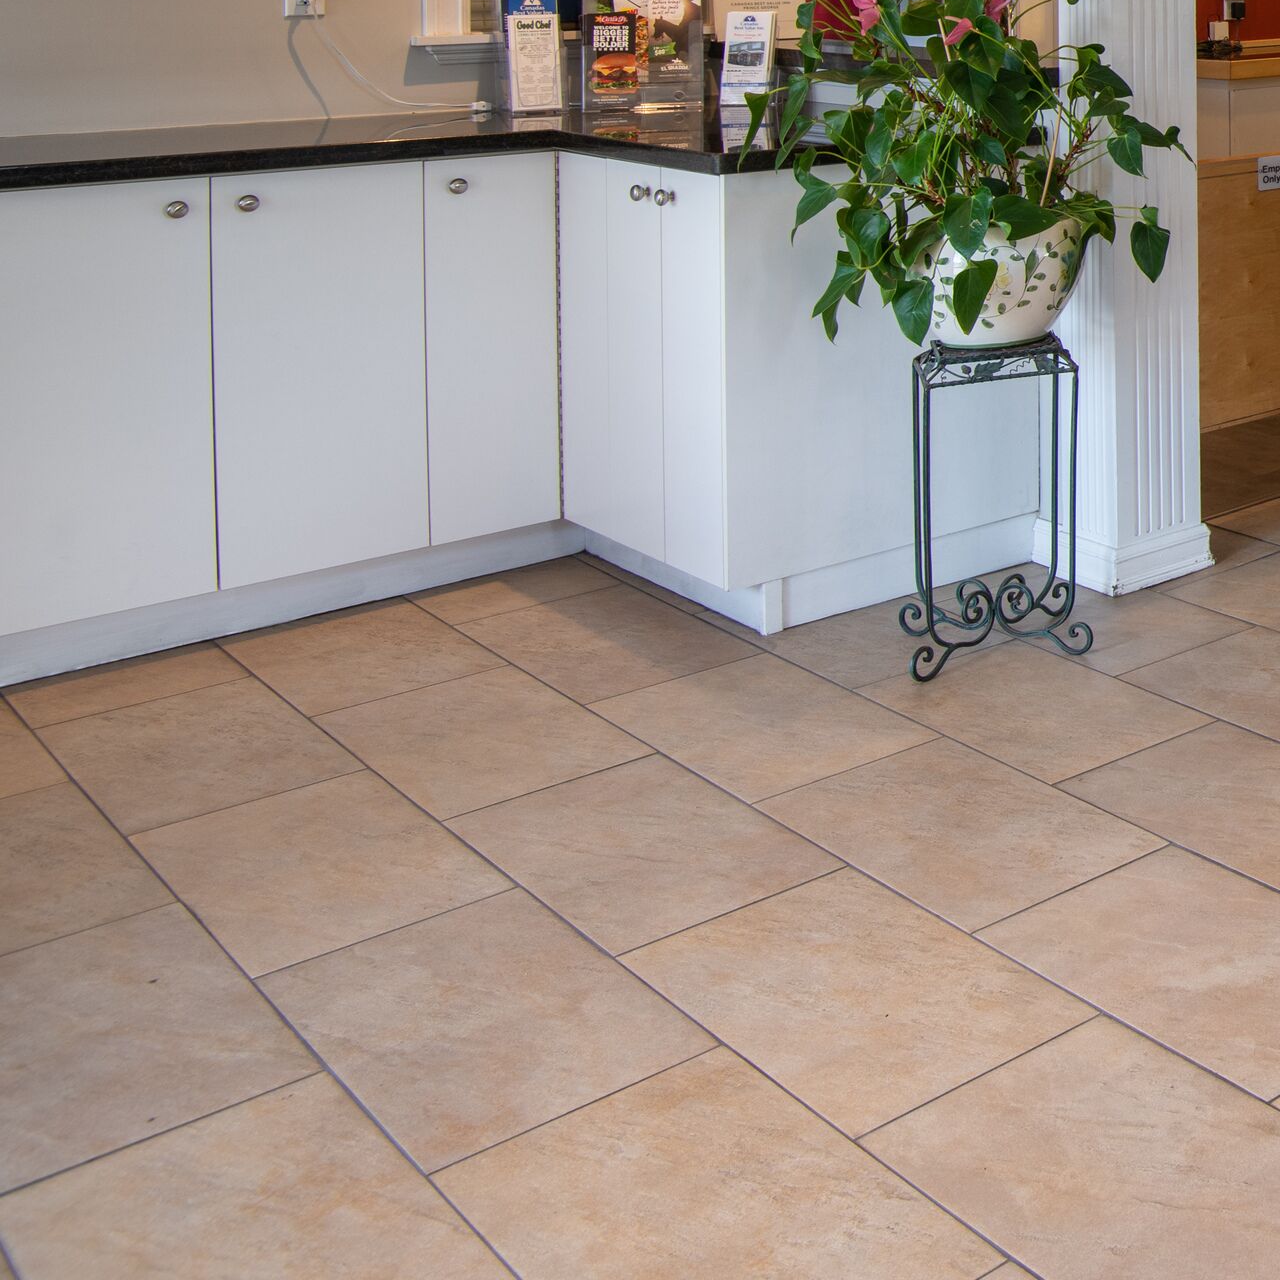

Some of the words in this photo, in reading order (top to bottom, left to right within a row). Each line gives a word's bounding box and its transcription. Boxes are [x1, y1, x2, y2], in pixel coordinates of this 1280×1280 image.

[517, 21, 533, 29] Good
[535, 20, 551, 29] Chef
[1263, 176, 1280, 184] Only
